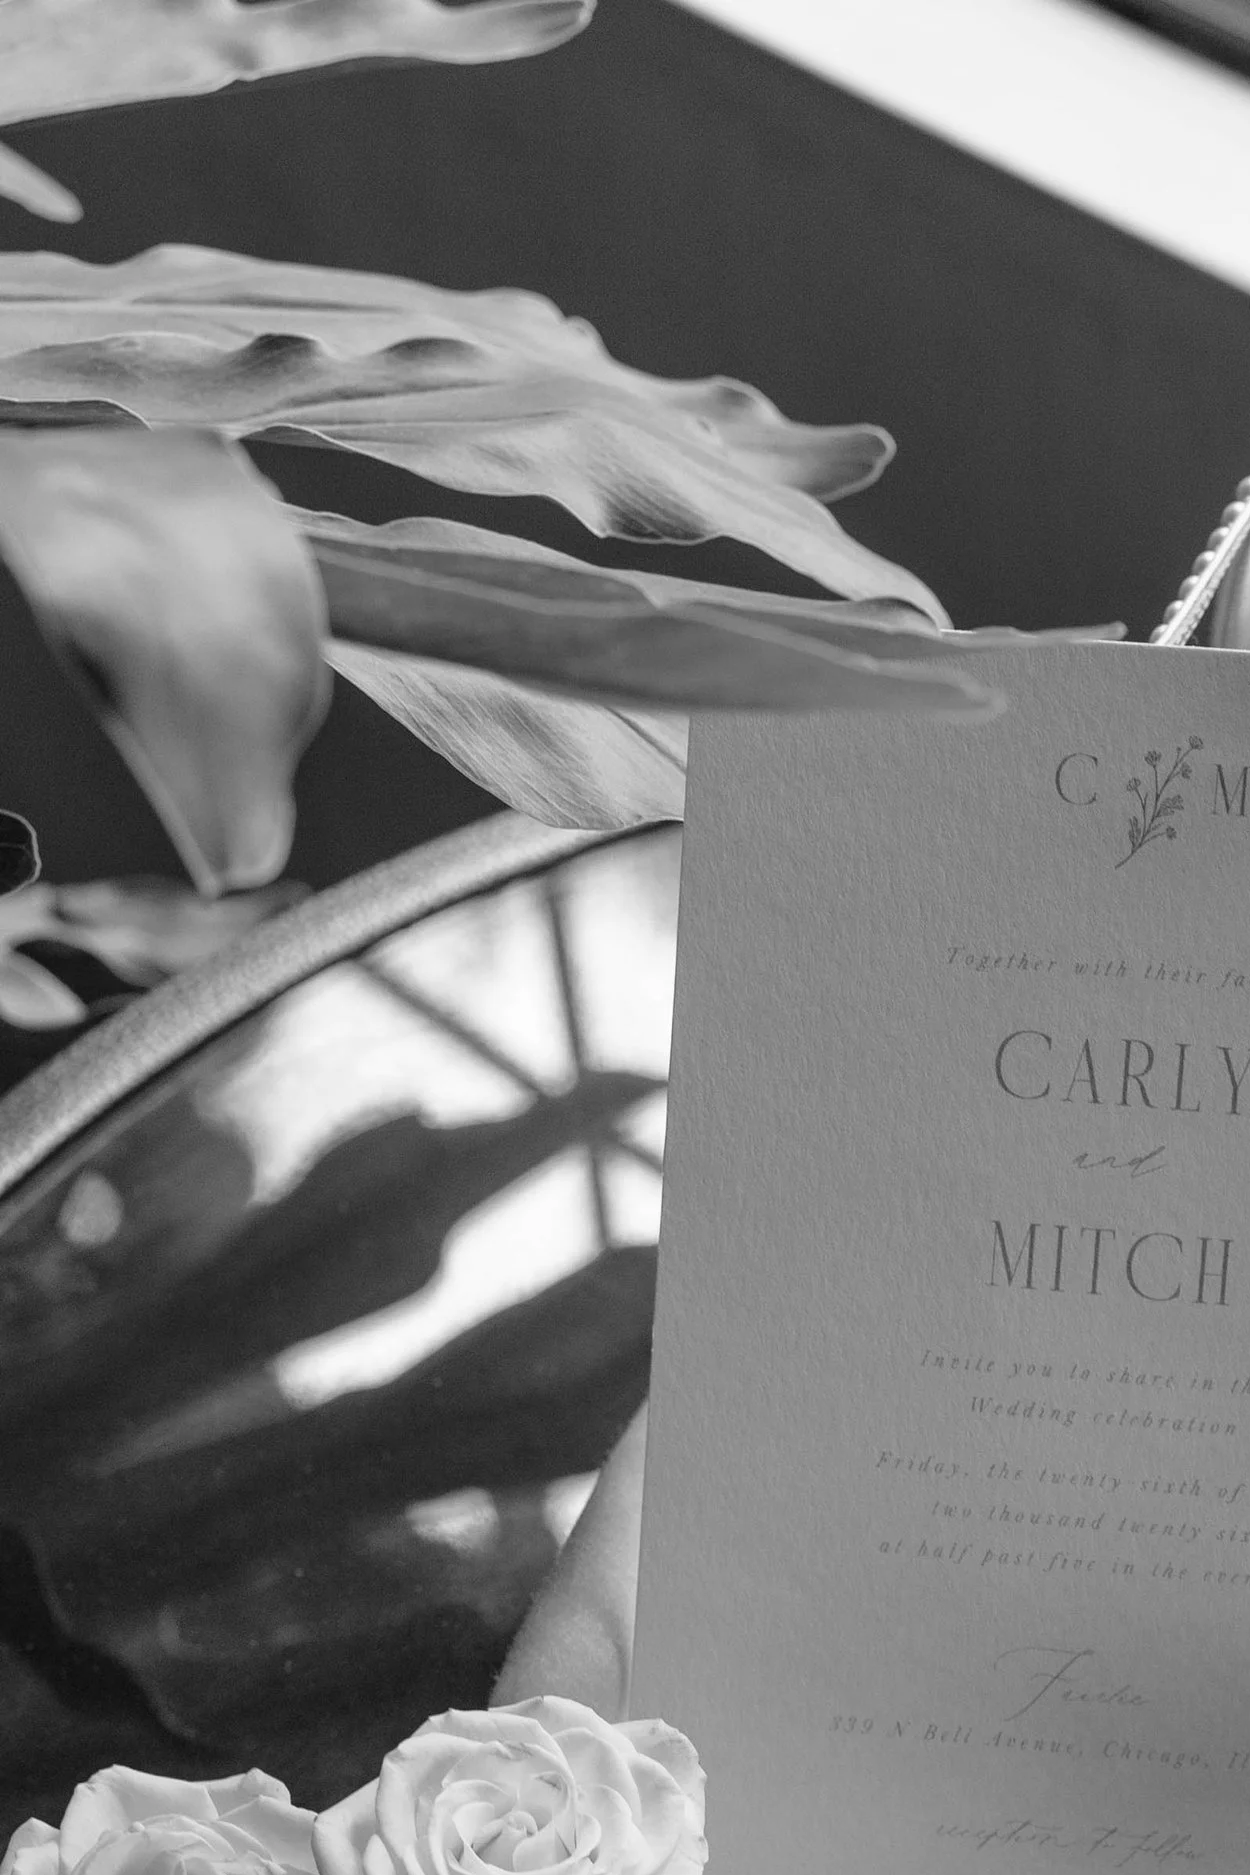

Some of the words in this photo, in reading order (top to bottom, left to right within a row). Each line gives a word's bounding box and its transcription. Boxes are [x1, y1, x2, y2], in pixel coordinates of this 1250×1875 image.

[1055, 752, 1098, 806] C
[948, 945, 1057, 974] Together
[1074, 958, 1128, 979] with
[1144, 960, 1207, 985] their
[1073, 1146, 1167, 1176] and
[985, 1220, 1235, 1307] MITCH
[919, 1348, 996, 1374] Invite
[1007, 1360, 1054, 1381] you
[1068, 1362, 1092, 1382] to
[1106, 1366, 1176, 1390] share
[1190, 1370, 1215, 1393] in
[970, 1396, 1077, 1429] Wedding
[1092, 1408, 1238, 1437] celebration
[875, 1450, 970, 1480] Friday,
[986, 1461, 1025, 1482] the
[1038, 1466, 1122, 1493] twenty
[1140, 1474, 1202, 1498] sixth
[1217, 1481, 1248, 1506] of
[931, 1499, 974, 1520] two
[987, 1503, 1106, 1532] thousand
[1117, 1515, 1202, 1543] twenty
[878, 1537, 904, 1556] at
[916, 1538, 974, 1565] half
[980, 1545, 1036, 1569] past
[1043, 1549, 1098, 1573] five
[1111, 1555, 1137, 1577] in
[1152, 1560, 1189, 1581] the
[922, 1722, 974, 1745] Bell
